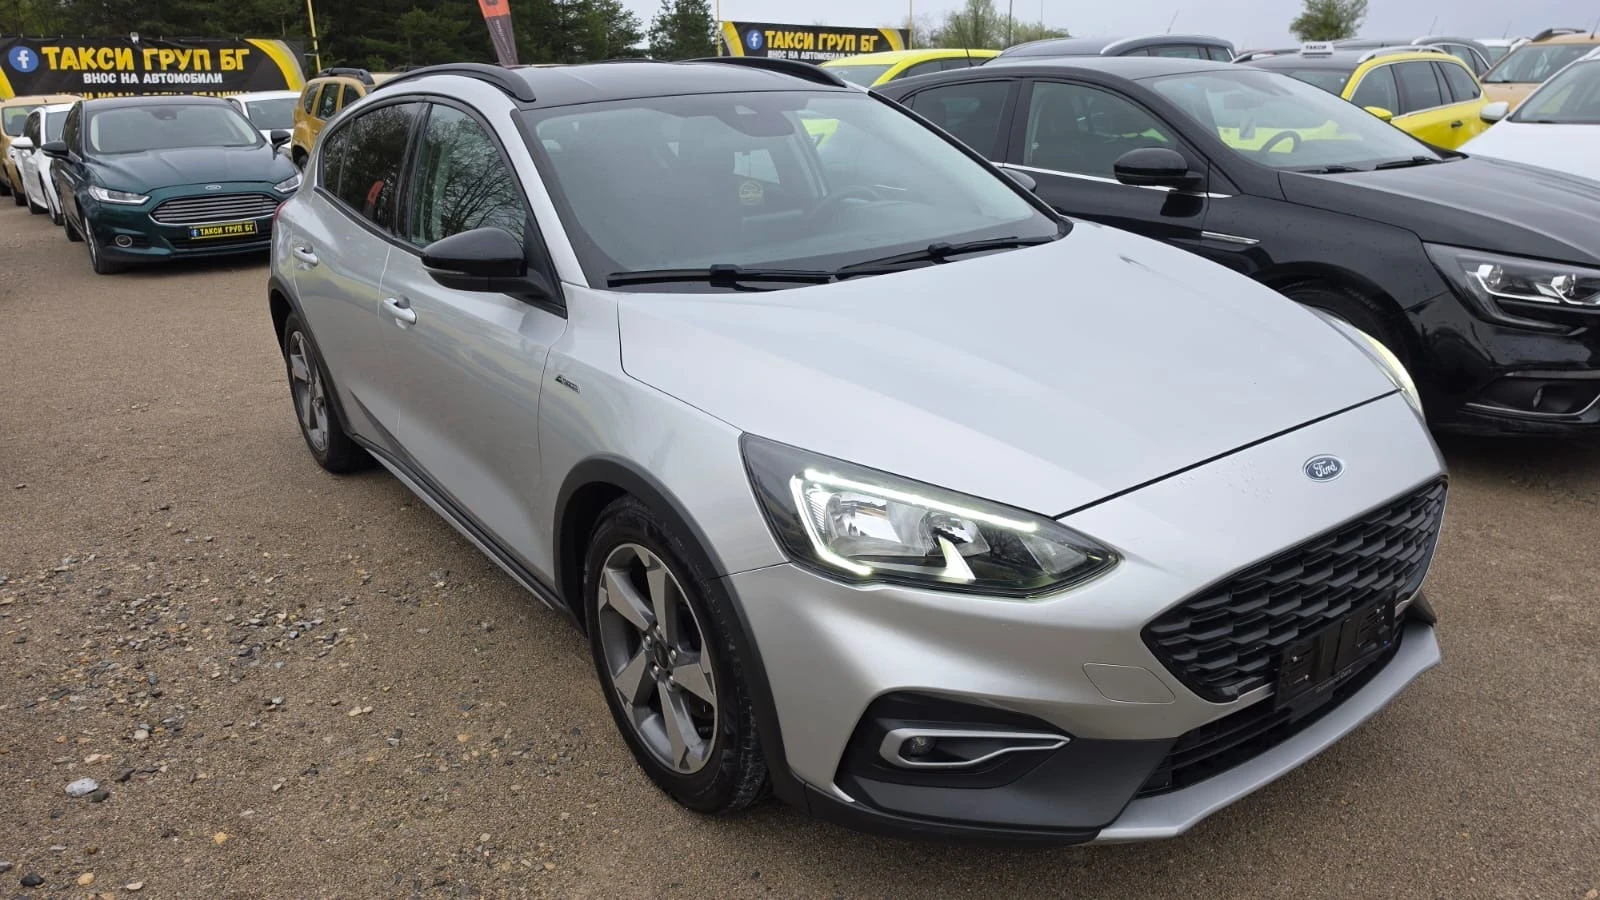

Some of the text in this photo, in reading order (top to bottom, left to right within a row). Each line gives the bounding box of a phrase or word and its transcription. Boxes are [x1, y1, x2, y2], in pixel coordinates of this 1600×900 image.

[764, 31, 879, 52] ТАКСИ ГРУП БГ
[41, 46, 250, 71] ТАКСИ ГРУП БГ
[788, 50, 799, 60] НА
[83, 72, 223, 84] ВНОС НА АВТОМОБИЛИ
[200, 227, 223, 236] ТАКСИ
[224, 225, 243, 233] ГРУП
[1313, 460, 1338, 477] Ford
